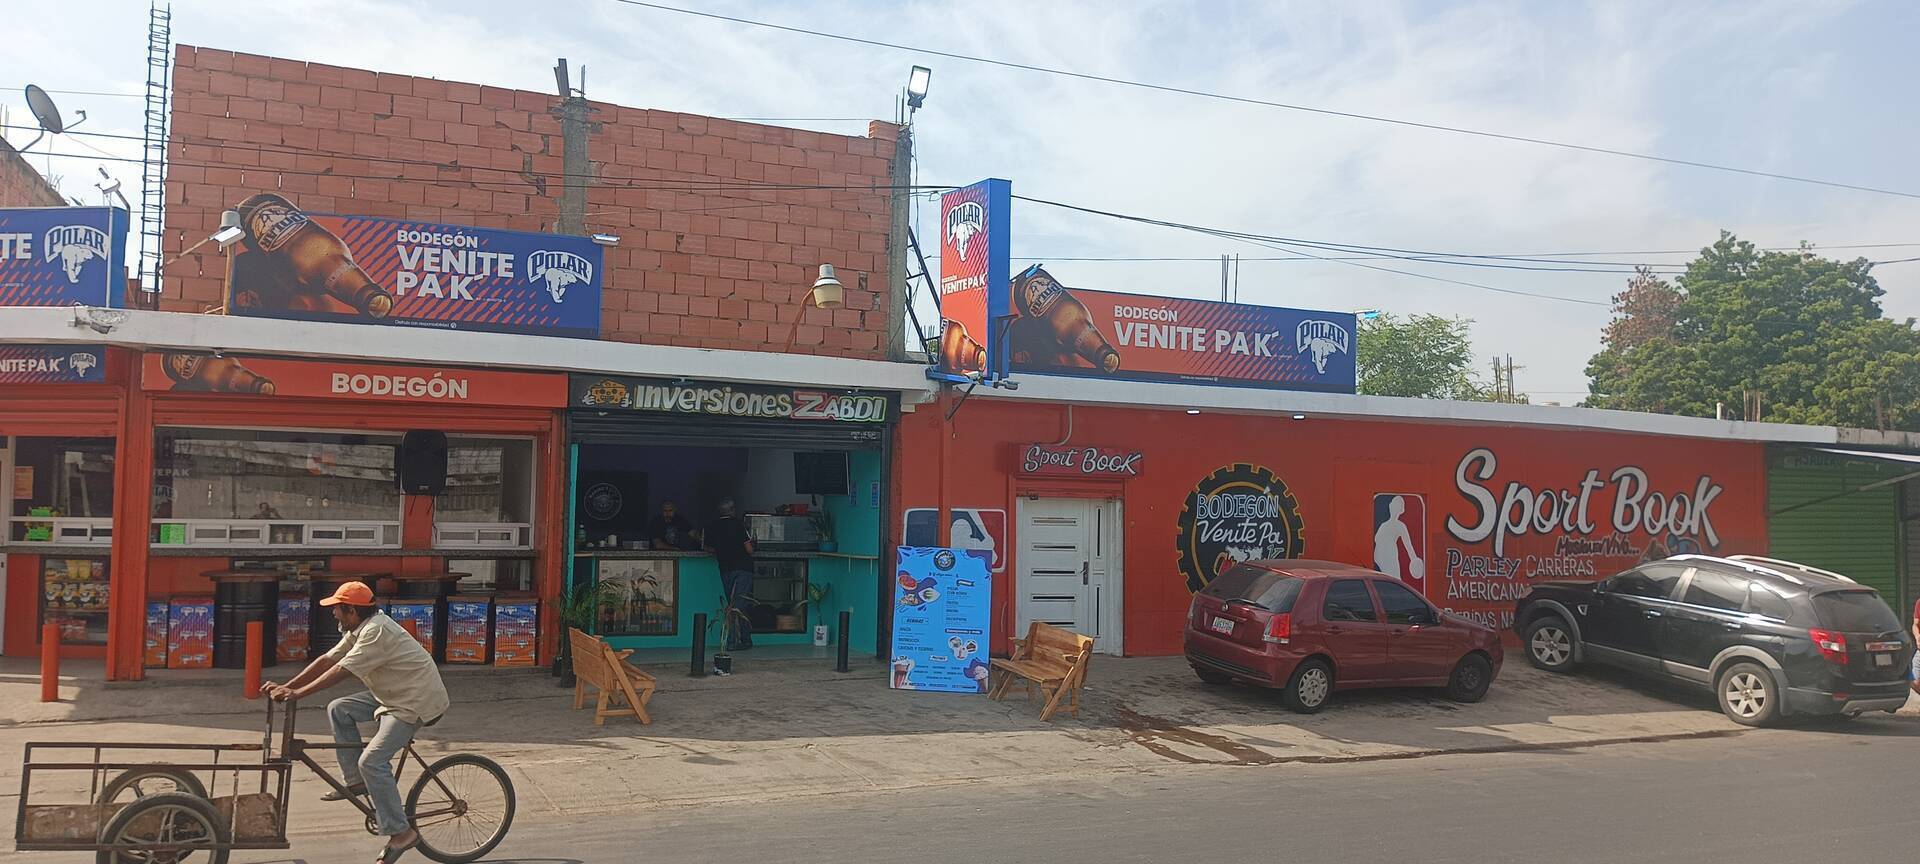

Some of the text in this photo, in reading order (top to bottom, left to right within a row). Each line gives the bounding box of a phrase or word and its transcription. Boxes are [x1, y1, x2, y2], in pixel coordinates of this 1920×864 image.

[949, 204, 981, 236] POLAR
[48, 227, 105, 255] POLAR
[397, 229, 478, 249] BODEGÓN
[396, 244, 515, 278] VENITE
[530, 252, 589, 278] POLAR
[1114, 305, 1178, 323] BODEGÓN
[1113, 321, 1206, 352] VENITE
[1299, 321, 1348, 348] POLAR
[331, 371, 468, 399] BODEGÓN
[1023, 445, 1078, 473] Sport
[1446, 448, 1604, 558] Sport
[1196, 518, 1258, 544] Venite
[1445, 547, 1522, 579] PARLEY
